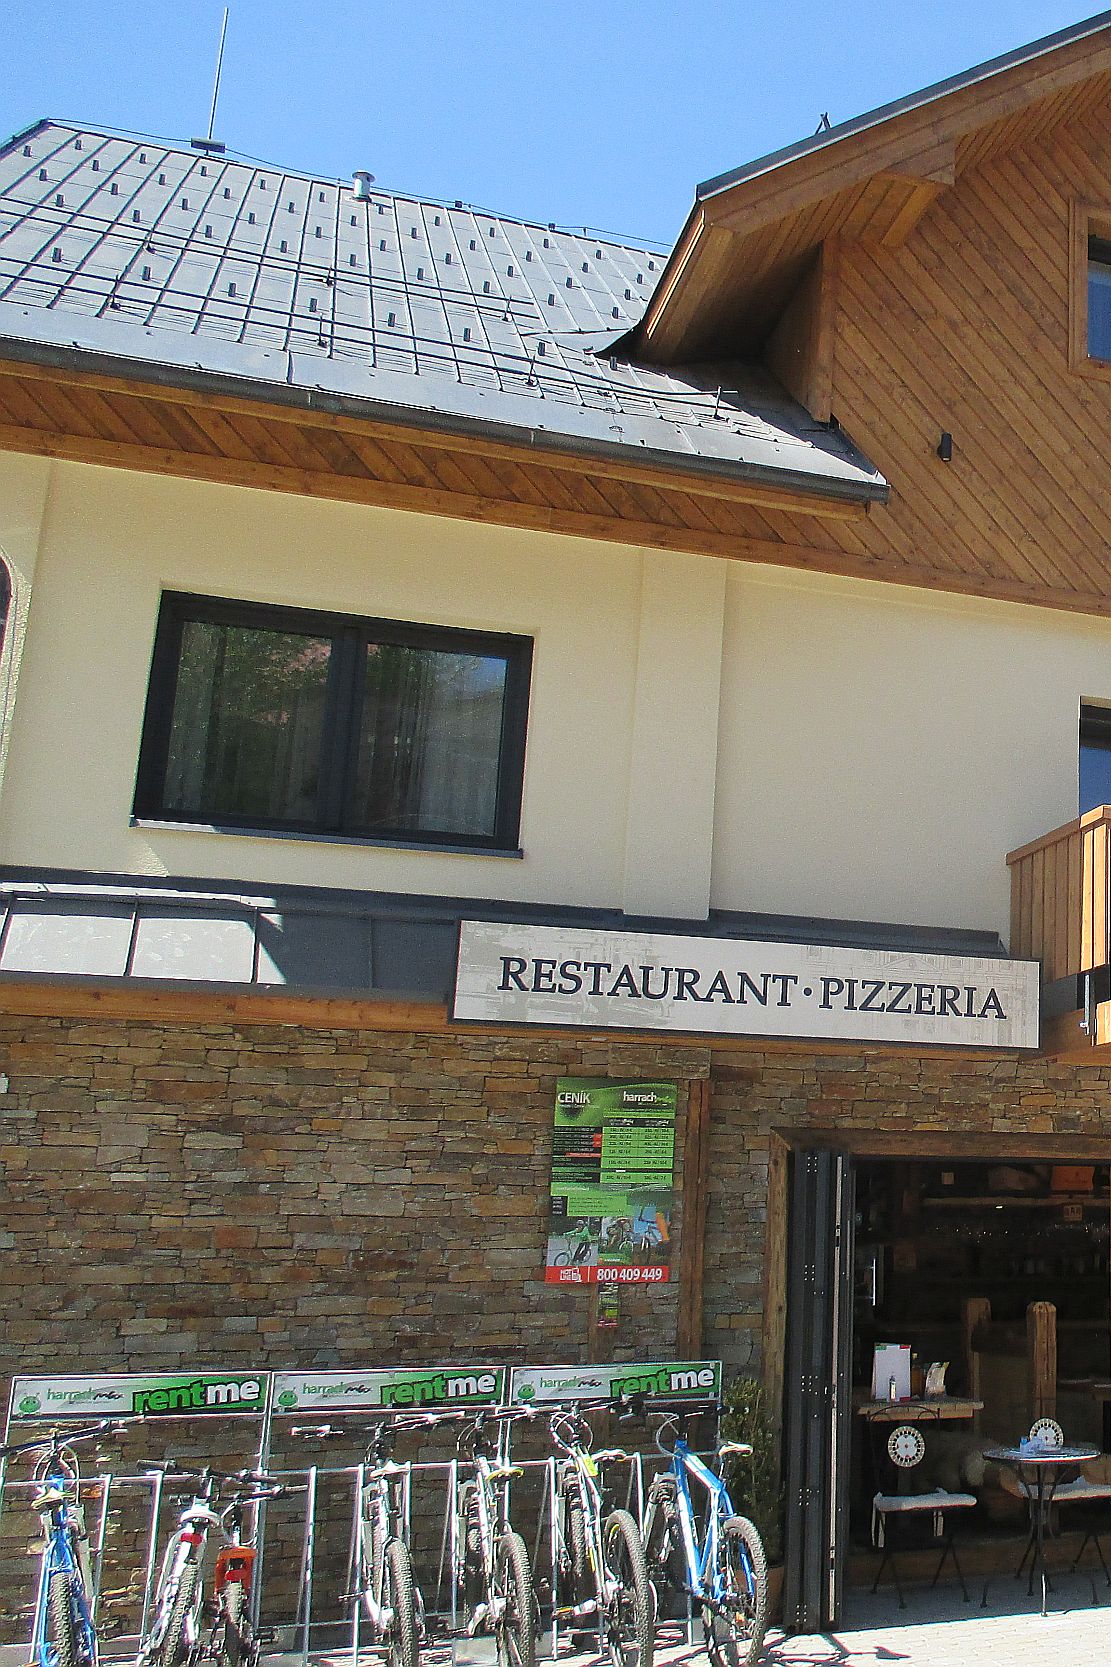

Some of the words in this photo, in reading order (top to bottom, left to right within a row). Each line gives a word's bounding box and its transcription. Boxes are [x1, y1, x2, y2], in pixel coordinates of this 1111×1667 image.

[497, 956, 798, 1007] RESTAURANT
[819, 976, 1006, 1019] PIZZERIA
[558, 1091, 591, 1104] CENÍK
[597, 1269, 618, 1281] 800
[619, 1269, 640, 1281] 409
[642, 1268, 663, 1281] 449
